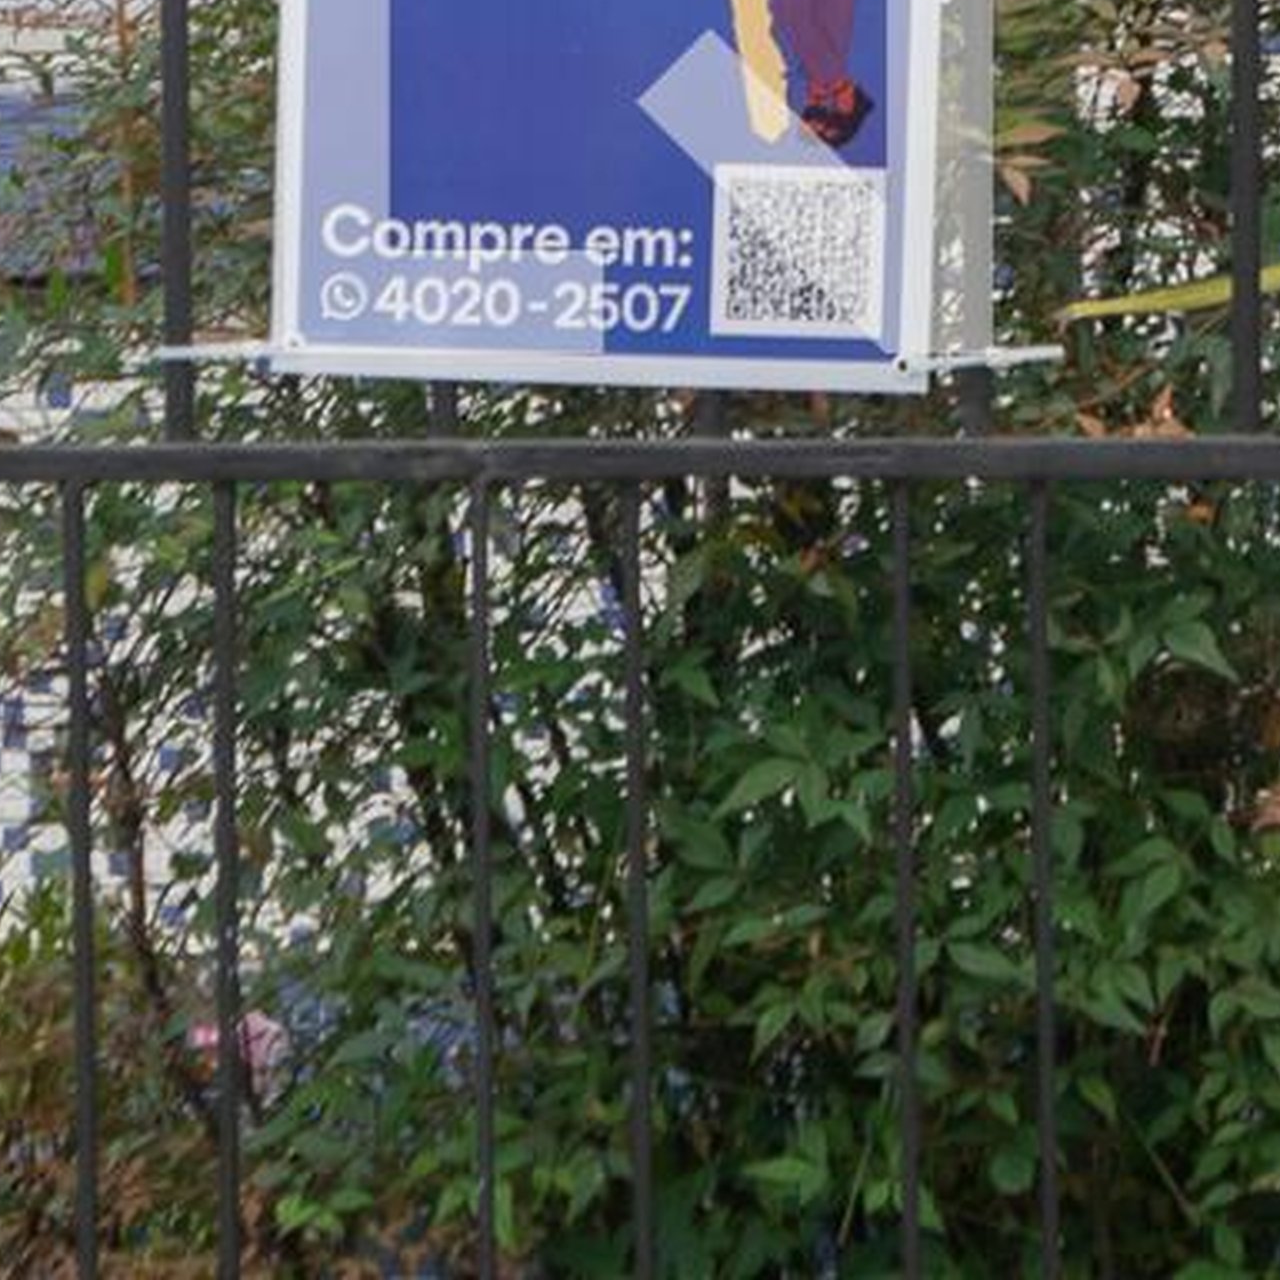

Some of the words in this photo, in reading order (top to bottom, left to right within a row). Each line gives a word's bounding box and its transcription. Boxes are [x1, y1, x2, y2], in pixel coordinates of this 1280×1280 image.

[321, 202, 572, 272] Compre
[582, 222, 695, 269] em:
[375, 278, 693, 332] 4020-2507
